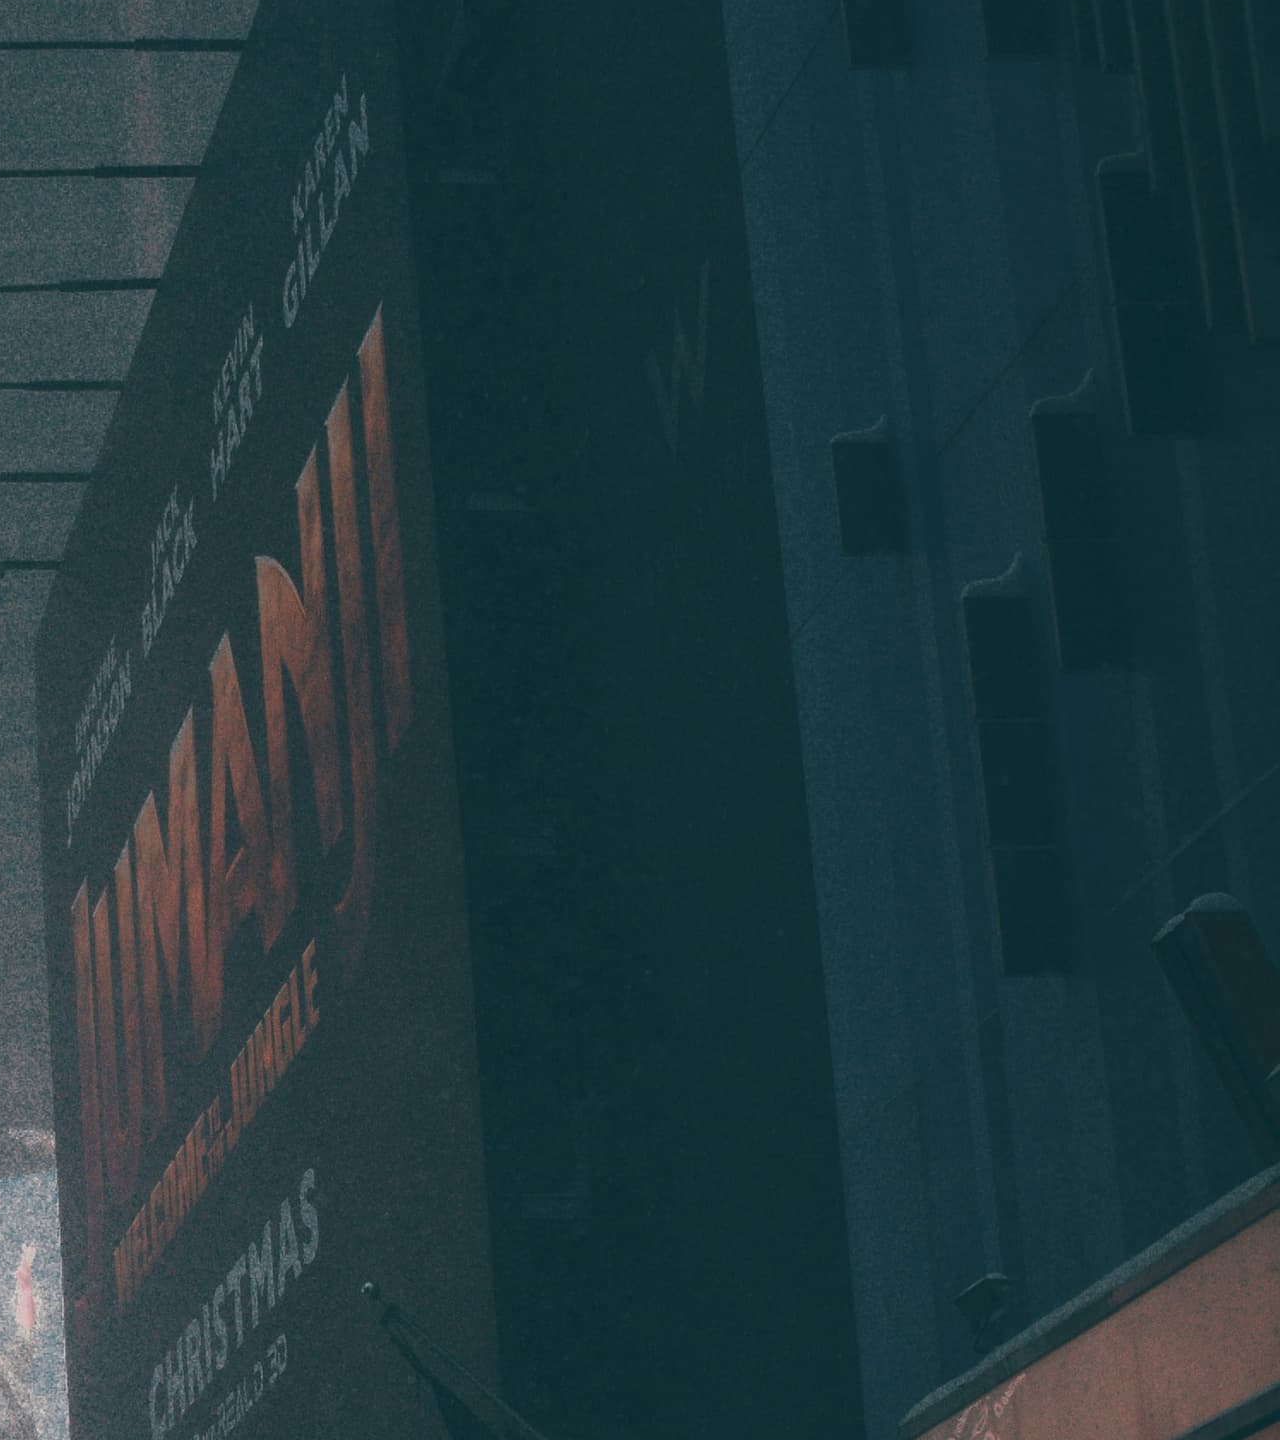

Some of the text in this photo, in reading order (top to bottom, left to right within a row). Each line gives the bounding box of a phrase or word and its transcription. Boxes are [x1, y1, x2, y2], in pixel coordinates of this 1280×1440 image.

[282, 92, 370, 329] GILLAN
[292, 71, 349, 236] KAREN
[210, 334, 264, 503] HART
[212, 300, 255, 425] KEVIN
[142, 495, 198, 659] BLACK
[151, 482, 181, 586] JACK
[67, 648, 132, 849] JOHNSON
[70, 300, 416, 1340] JUMANJI
[113, 1111, 208, 1312] WELCOME
[224, 937, 321, 1153] JUNGLE
